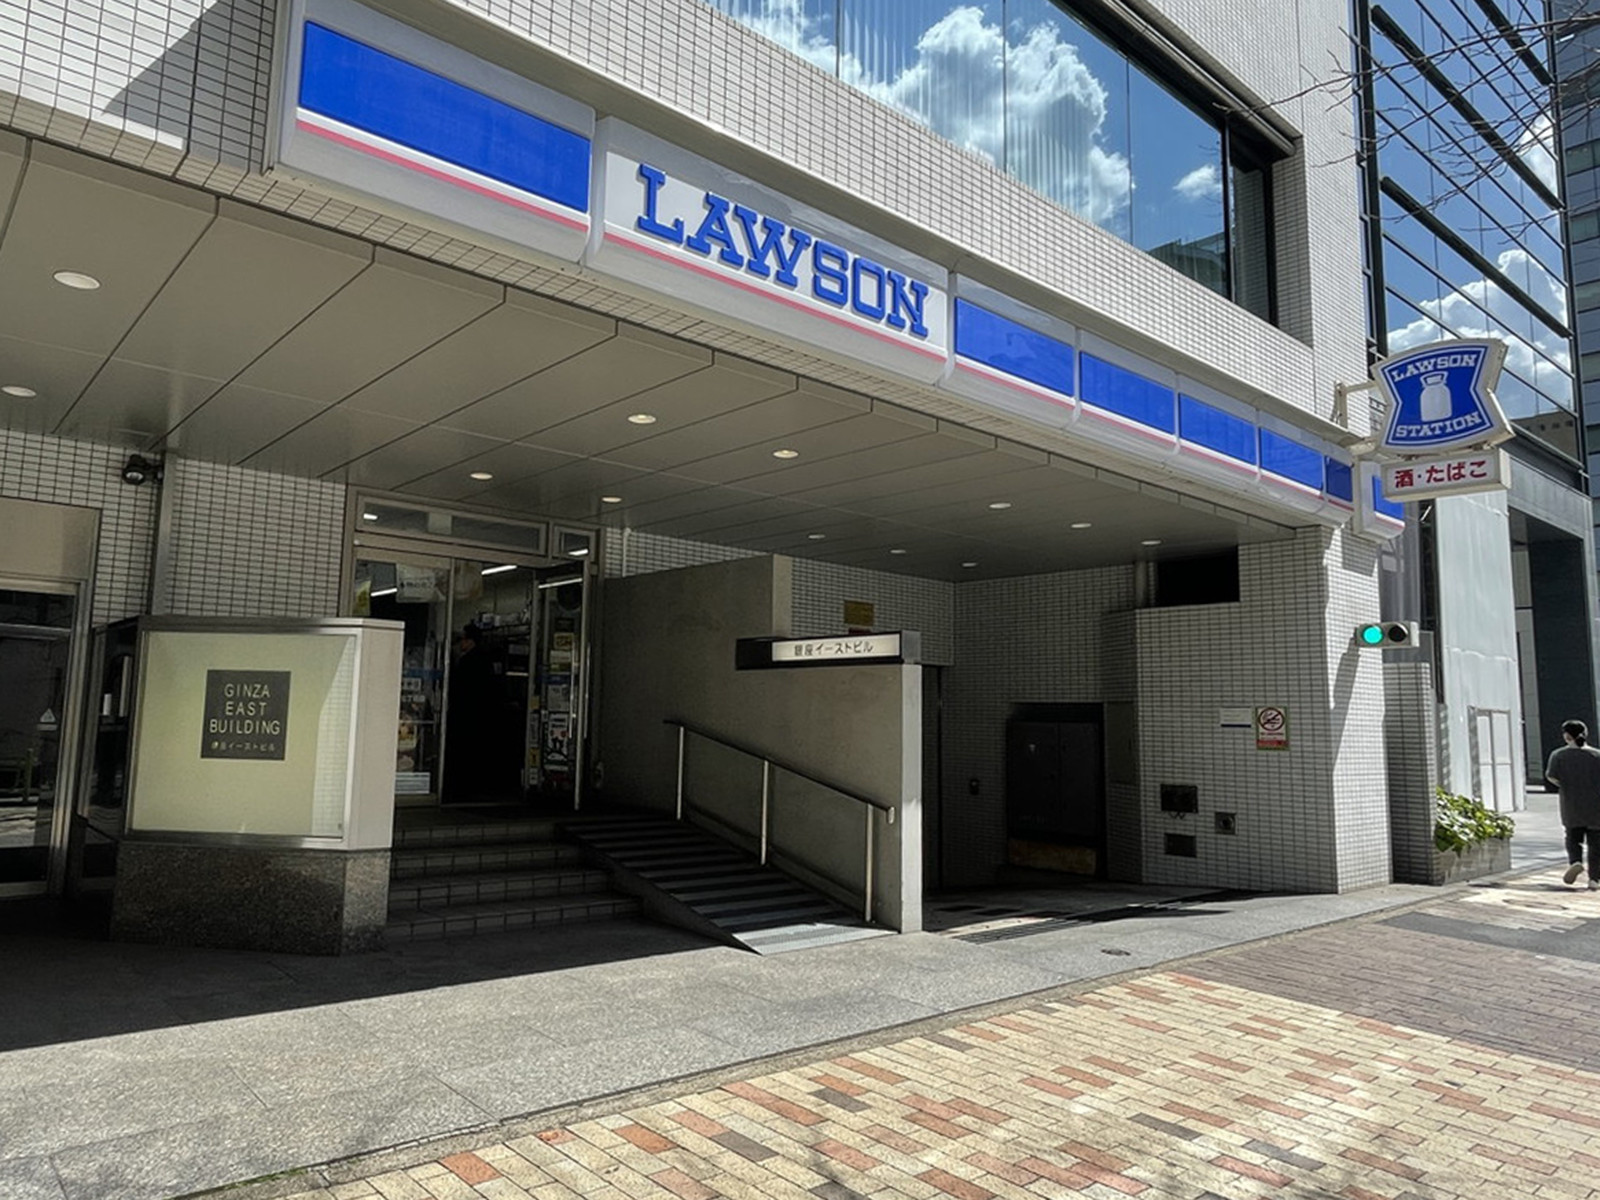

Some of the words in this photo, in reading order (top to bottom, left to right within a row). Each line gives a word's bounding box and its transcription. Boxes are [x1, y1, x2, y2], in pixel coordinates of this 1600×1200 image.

[635, 163, 929, 339] LAWSON
[1391, 354, 1477, 383] LAWSON
[1396, 411, 1482, 438] STATION
[1394, 460, 1488, 488] 酒・たばこ
[224, 683, 271, 698] GINZA
[225, 701, 267, 716] EAST
[209, 719, 281, 735] BUILDING
